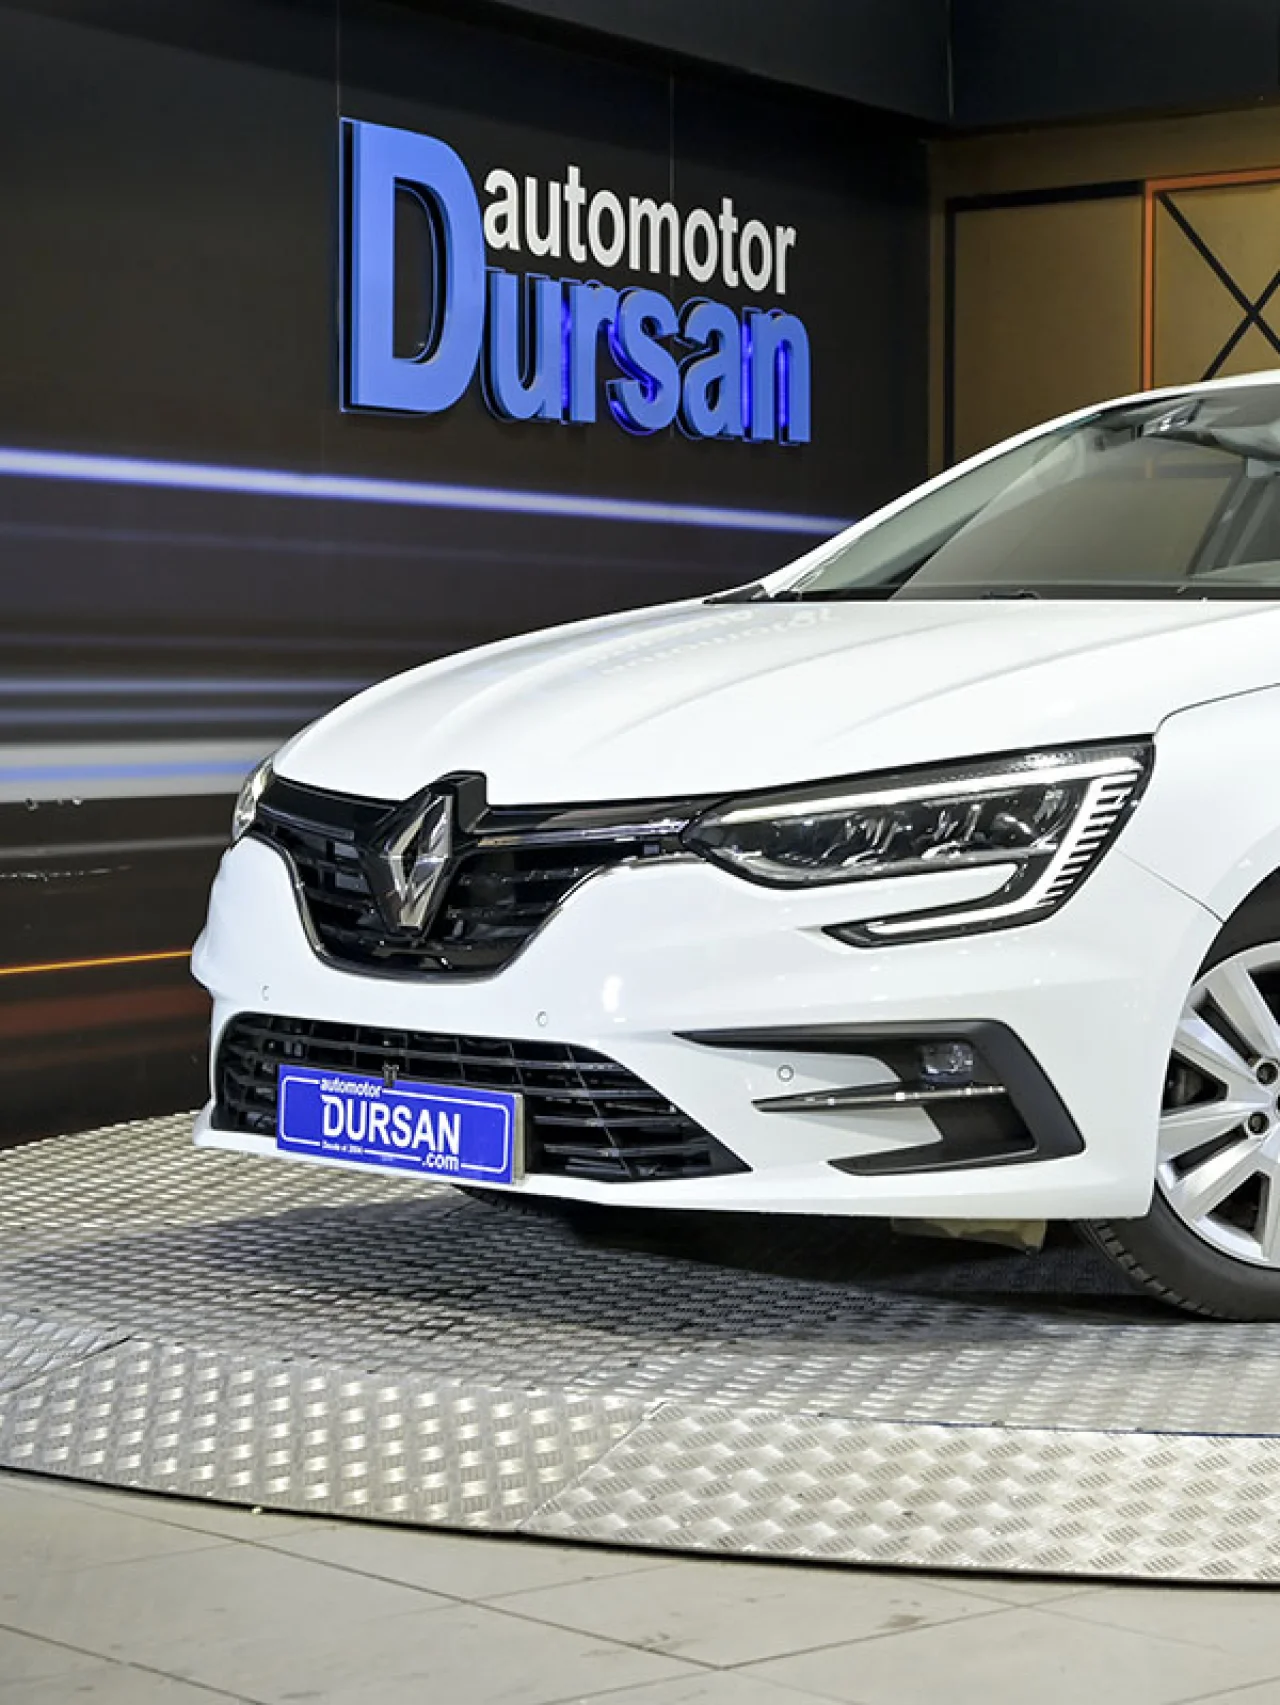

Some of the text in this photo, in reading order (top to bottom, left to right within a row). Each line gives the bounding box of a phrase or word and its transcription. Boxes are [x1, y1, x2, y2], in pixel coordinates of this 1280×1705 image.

[483, 165, 797, 295] automotor
[339, 116, 812, 445] Dursan
[320, 1077, 382, 1098] automotor
[320, 1095, 461, 1155] DURSAN
[421, 1151, 460, 1171] .com
